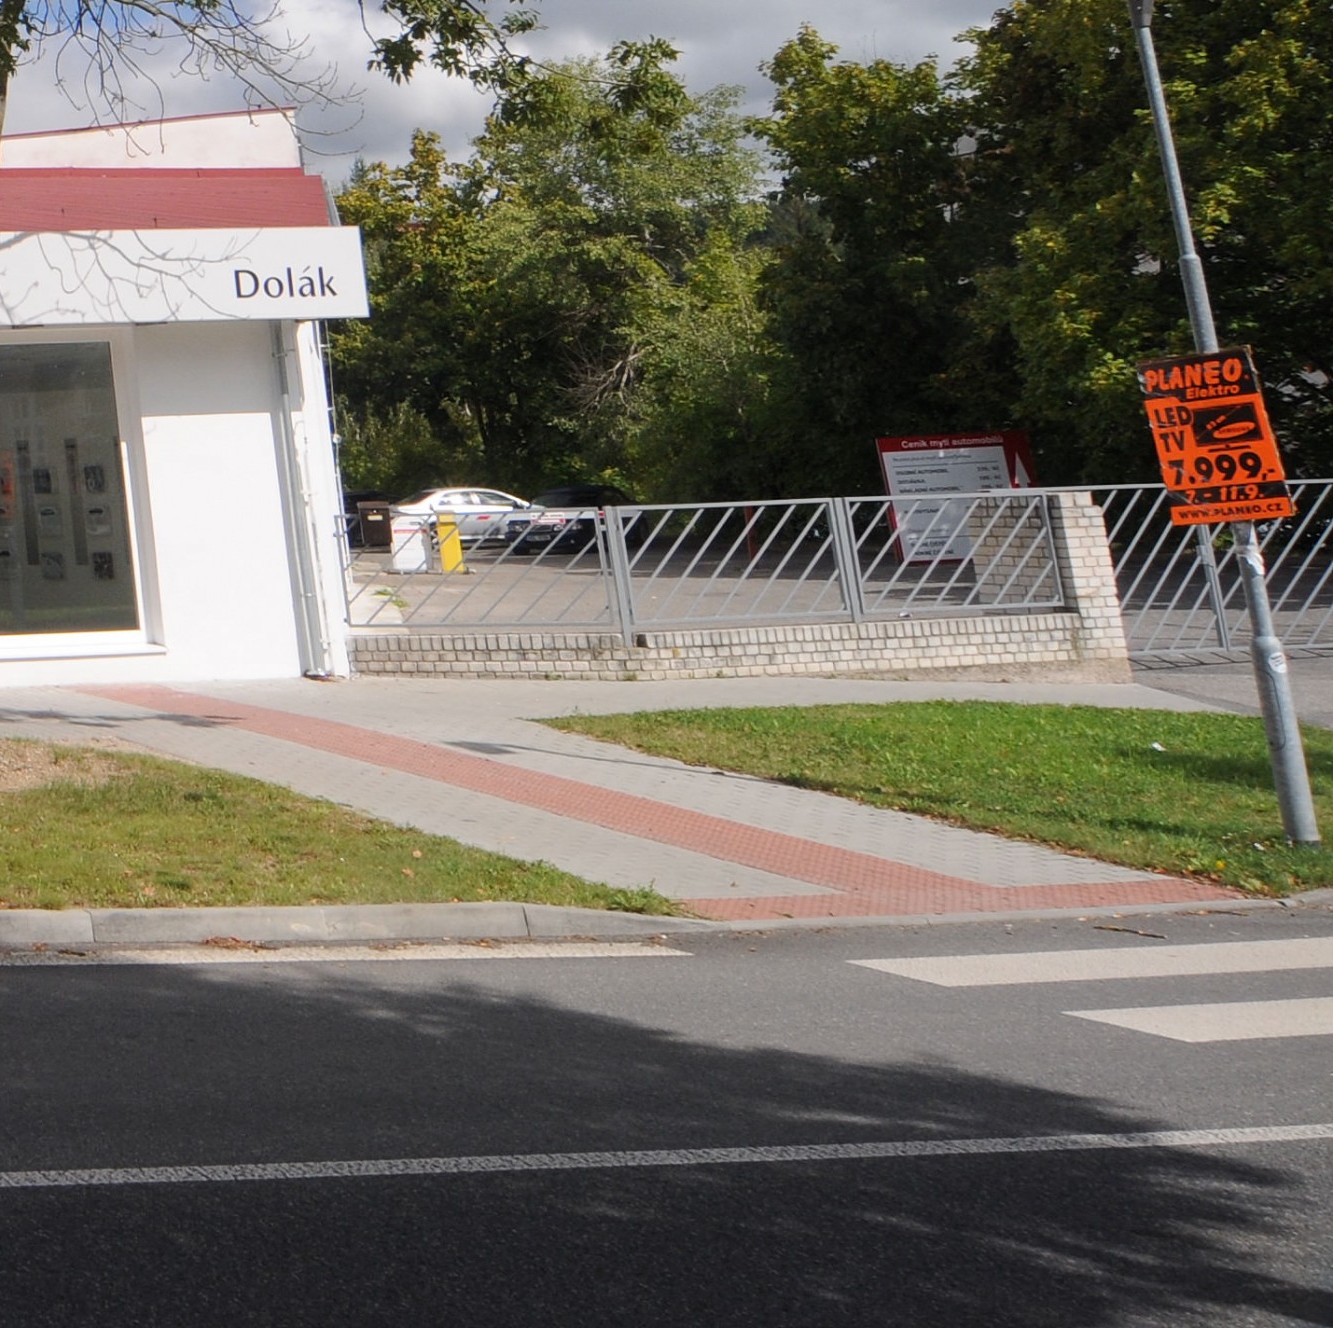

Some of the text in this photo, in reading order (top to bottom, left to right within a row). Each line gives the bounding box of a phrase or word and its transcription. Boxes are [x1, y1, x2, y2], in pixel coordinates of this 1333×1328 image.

[234, 265, 338, 299] Dolák
[1186, 385, 1241, 400] Elektro
[1154, 406, 1193, 429] LED
[1160, 430, 1186, 452] TV
